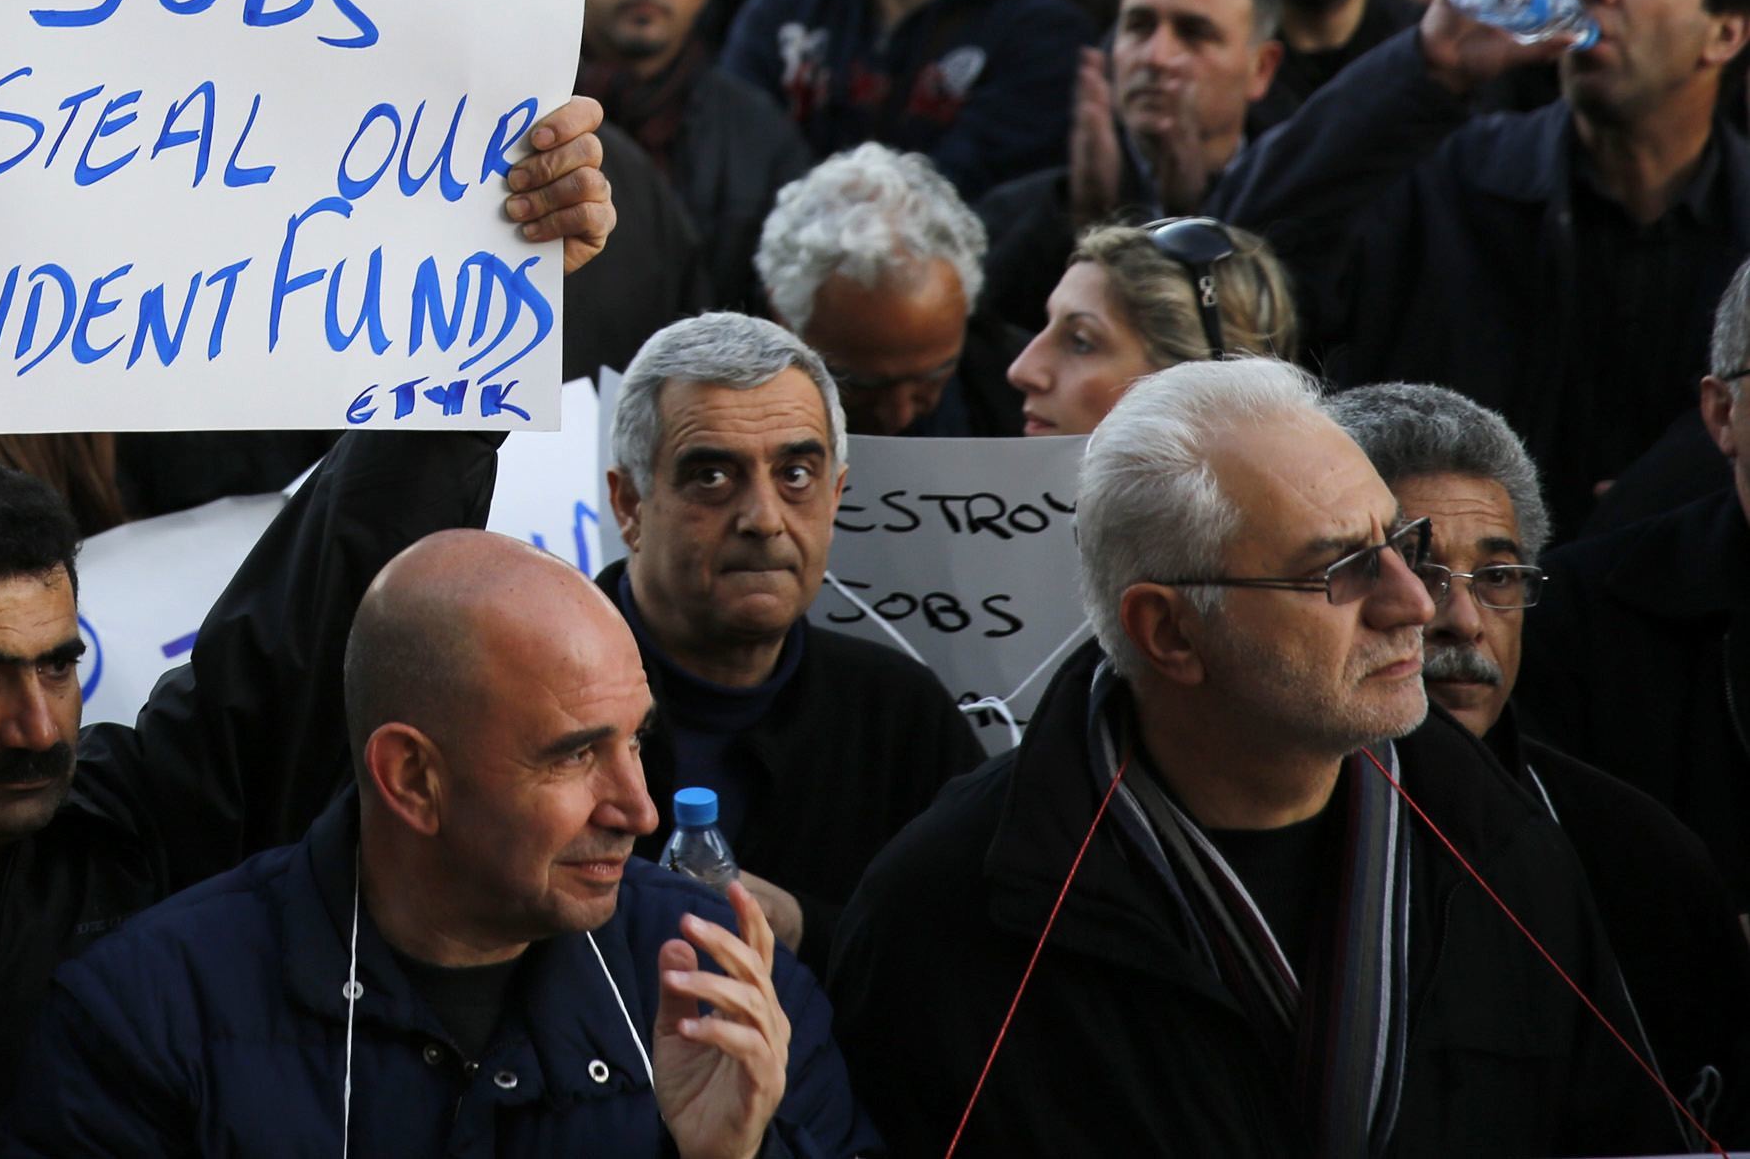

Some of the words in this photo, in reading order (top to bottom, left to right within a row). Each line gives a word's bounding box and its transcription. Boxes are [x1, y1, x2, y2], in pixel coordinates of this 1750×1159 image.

[336, 94, 539, 203] OUR
[269, 197, 555, 385] FUNDS
[822, 578, 1024, 638] JOBS
